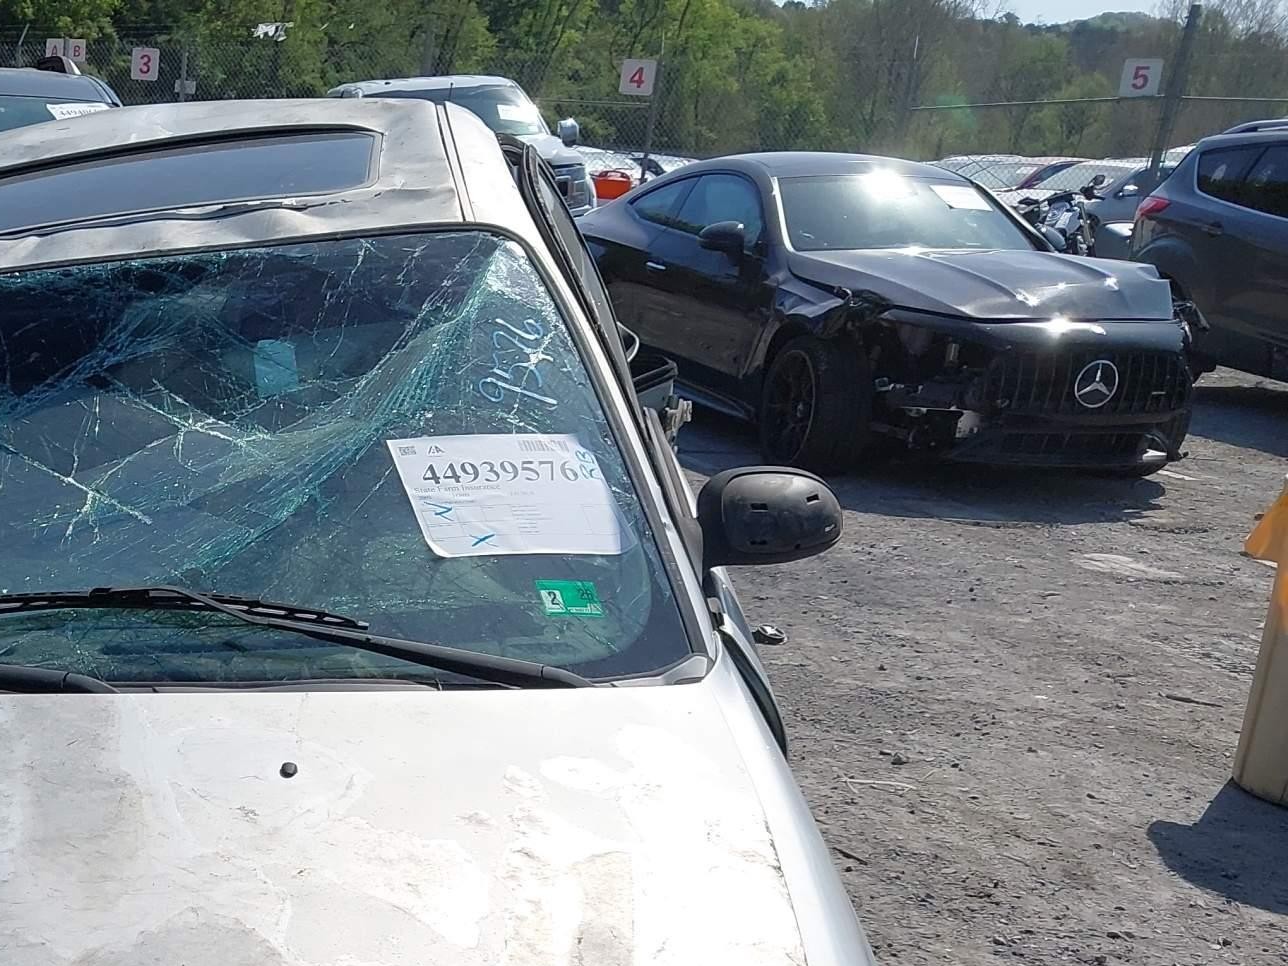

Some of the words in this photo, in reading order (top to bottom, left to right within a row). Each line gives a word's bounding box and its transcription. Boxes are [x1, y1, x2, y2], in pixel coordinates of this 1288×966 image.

[51, 45, 58, 56] A
[73, 45, 81, 57] B
[139, 54, 151, 74] 3
[629, 66, 645, 89] 4
[1131, 65, 1151, 90] 5
[422, 460, 579, 484] 44939576
[437, 485, 460, 493] Farm
[461, 484, 502, 492] Insurance
[547, 591, 561, 606] 2
